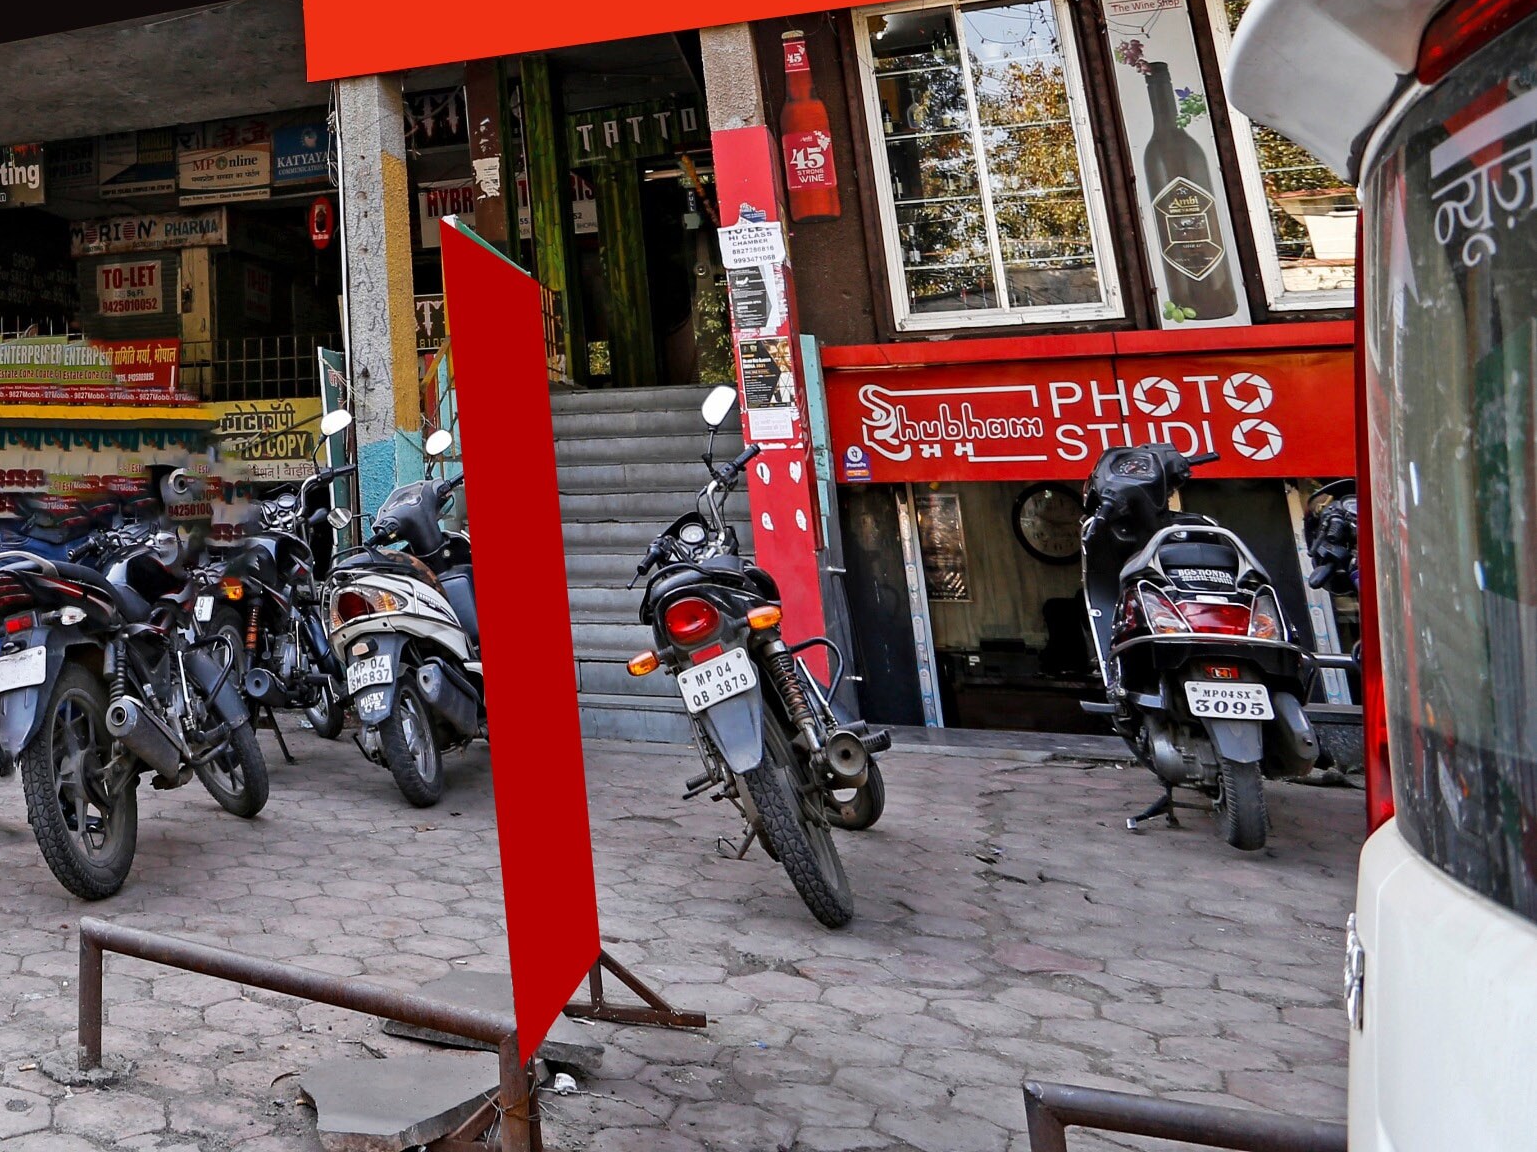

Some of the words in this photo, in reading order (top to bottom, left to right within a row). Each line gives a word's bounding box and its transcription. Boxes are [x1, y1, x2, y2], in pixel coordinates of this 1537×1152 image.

[1112, 3, 1132, 13] The
[1133, 0, 1156, 12] Wine
[786, 52, 802, 63] 45
[790, 146, 825, 170] 45
[799, 173, 825, 183] WINE
[1170, 195, 1199, 207] Ambi
[165, 219, 219, 236] PHARMA
[741, 231, 773, 240] CLASS
[732, 238, 768, 247] CHAMBER
[102, 265, 157, 290] TO-LET
[1048, 372, 1273, 418] PHOTO
[266, 434, 307, 457] COPY
[1055, 418, 1283, 461] STUDIO
[1177, 568, 1197, 576] BGS
[353, 661, 365, 676] MP
[370, 657, 384, 670] 04
[695, 671, 713, 687] MP
[716, 661, 732, 678] 04
[692, 689, 710, 707] QB
[716, 673, 749, 696] 3879
